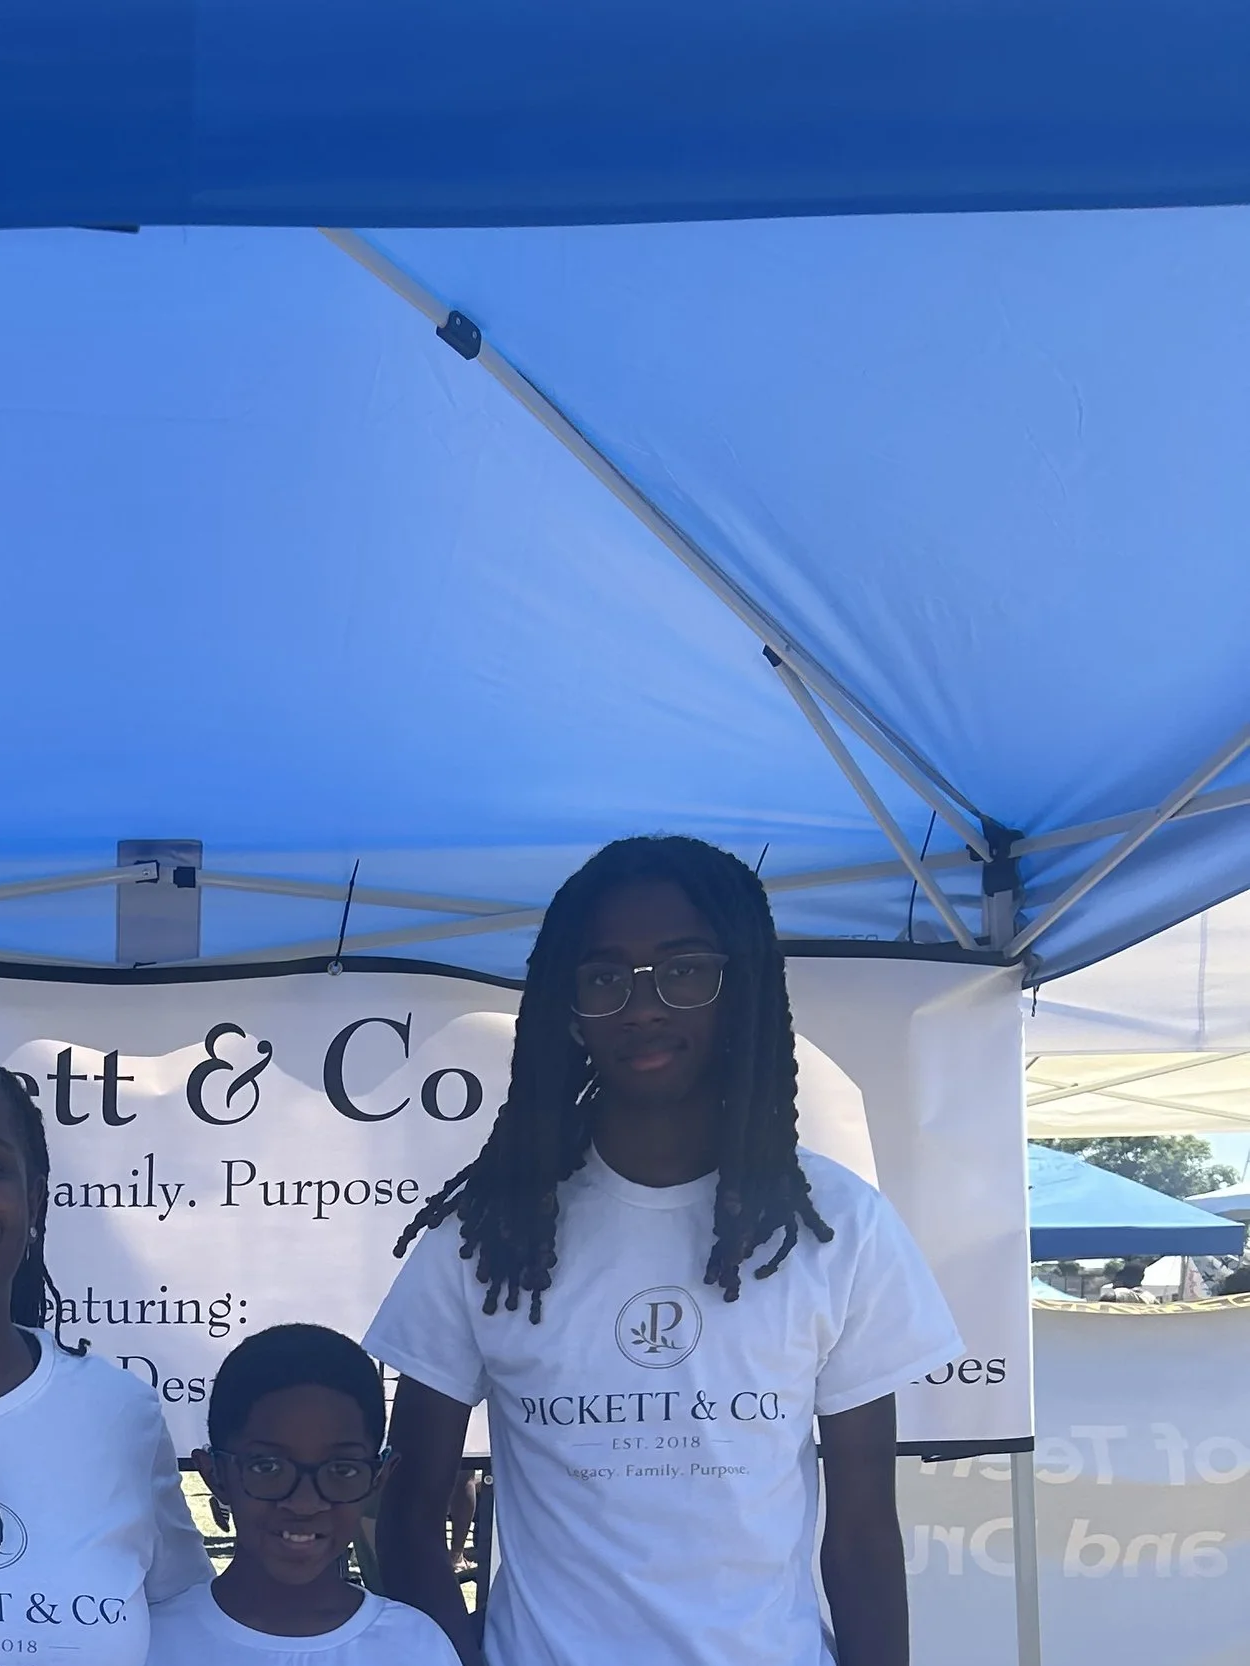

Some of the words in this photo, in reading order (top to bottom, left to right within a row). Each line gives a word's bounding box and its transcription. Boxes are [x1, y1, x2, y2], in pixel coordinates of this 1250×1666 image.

[187, 1022, 273, 1126] &
[54, 1153, 197, 1221] amily.
[40, 1286, 247, 1338] eaturing:
[643, 1300, 684, 1354] P
[520, 1391, 680, 1426] PICKETT
[690, 1390, 717, 1421] &
[730, 1391, 786, 1421] CO.
[612, 1438, 648, 1450] EST.
[655, 1436, 701, 1450] 2018
[626, 1464, 684, 1478] Family.
[690, 1463, 749, 1477] Purpose.
[26, 1592, 62, 1625] &
[71, 1594, 127, 1625] CO.
